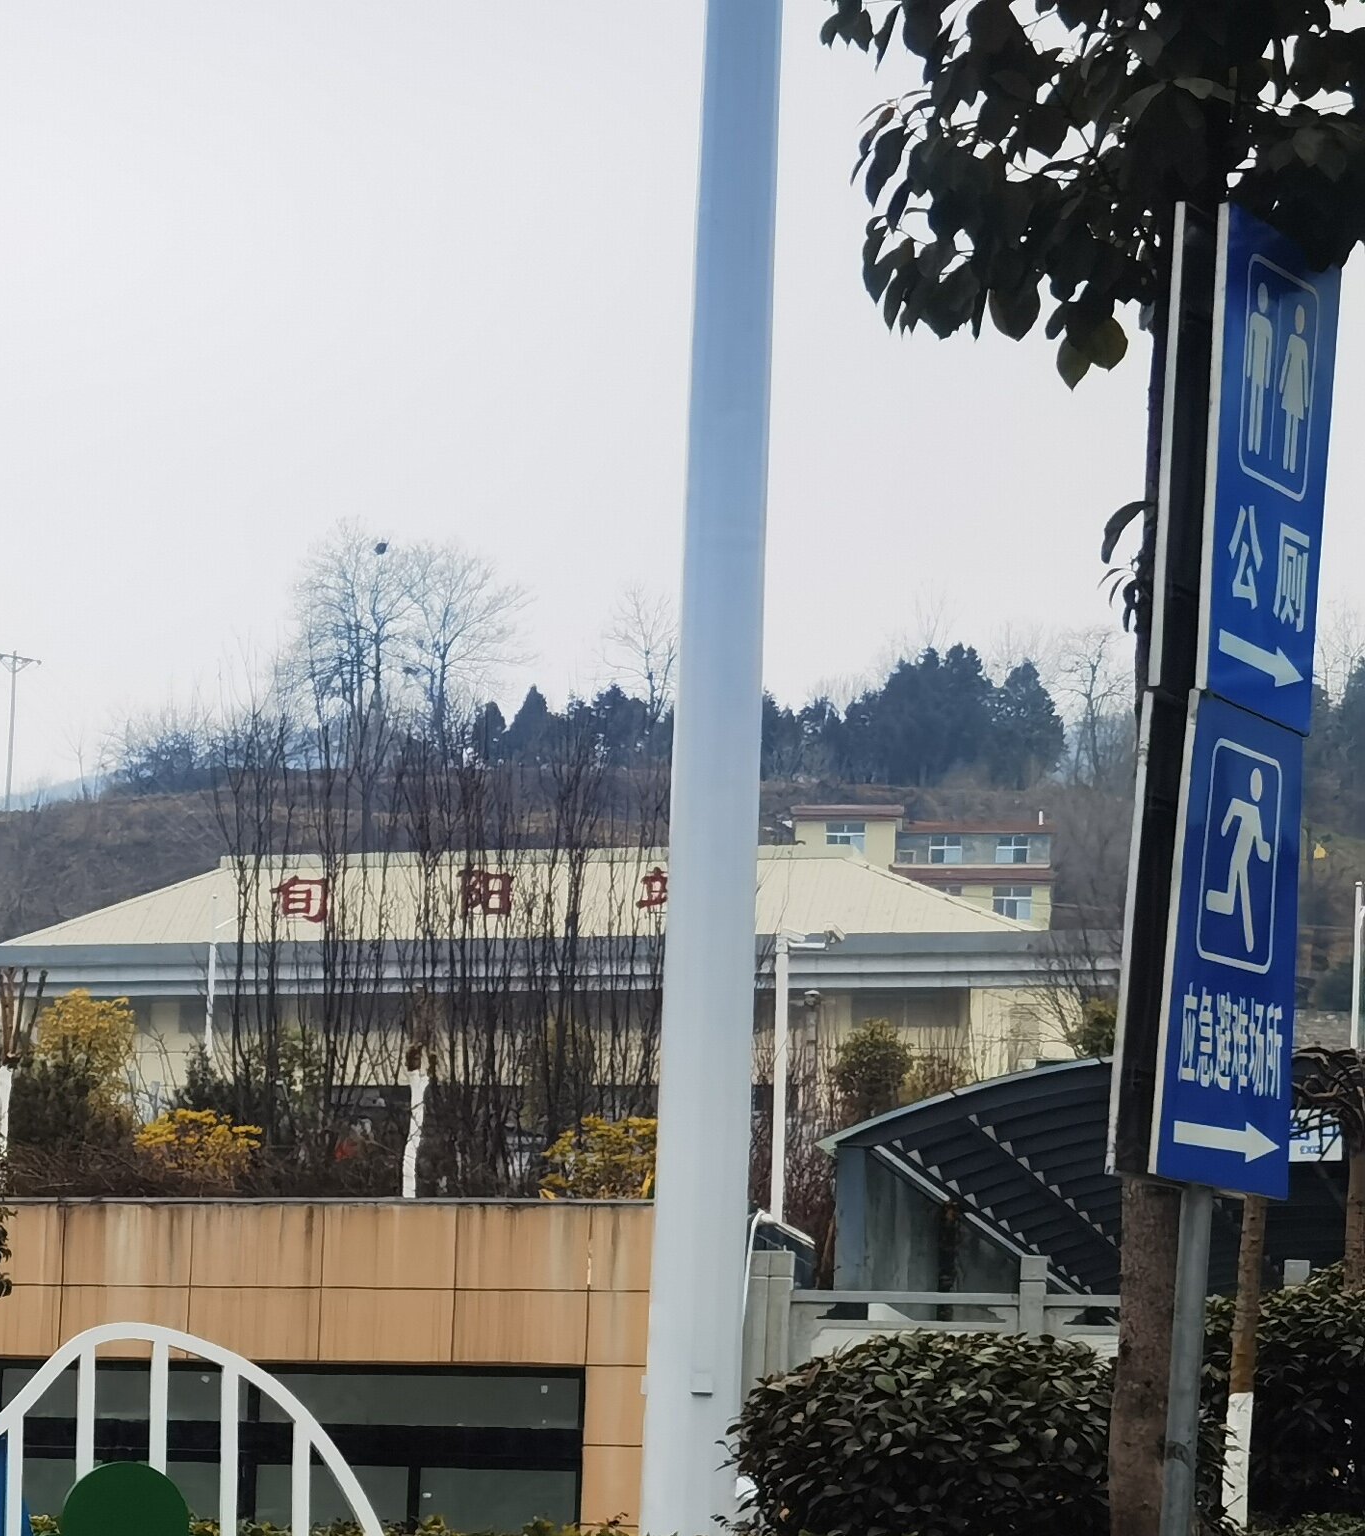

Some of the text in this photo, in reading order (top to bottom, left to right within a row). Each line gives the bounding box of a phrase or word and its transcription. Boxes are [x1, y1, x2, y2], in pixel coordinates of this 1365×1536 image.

[1228, 504, 1310, 633] 公厕
[1177, 981, 1283, 1100] 应急避难场所
